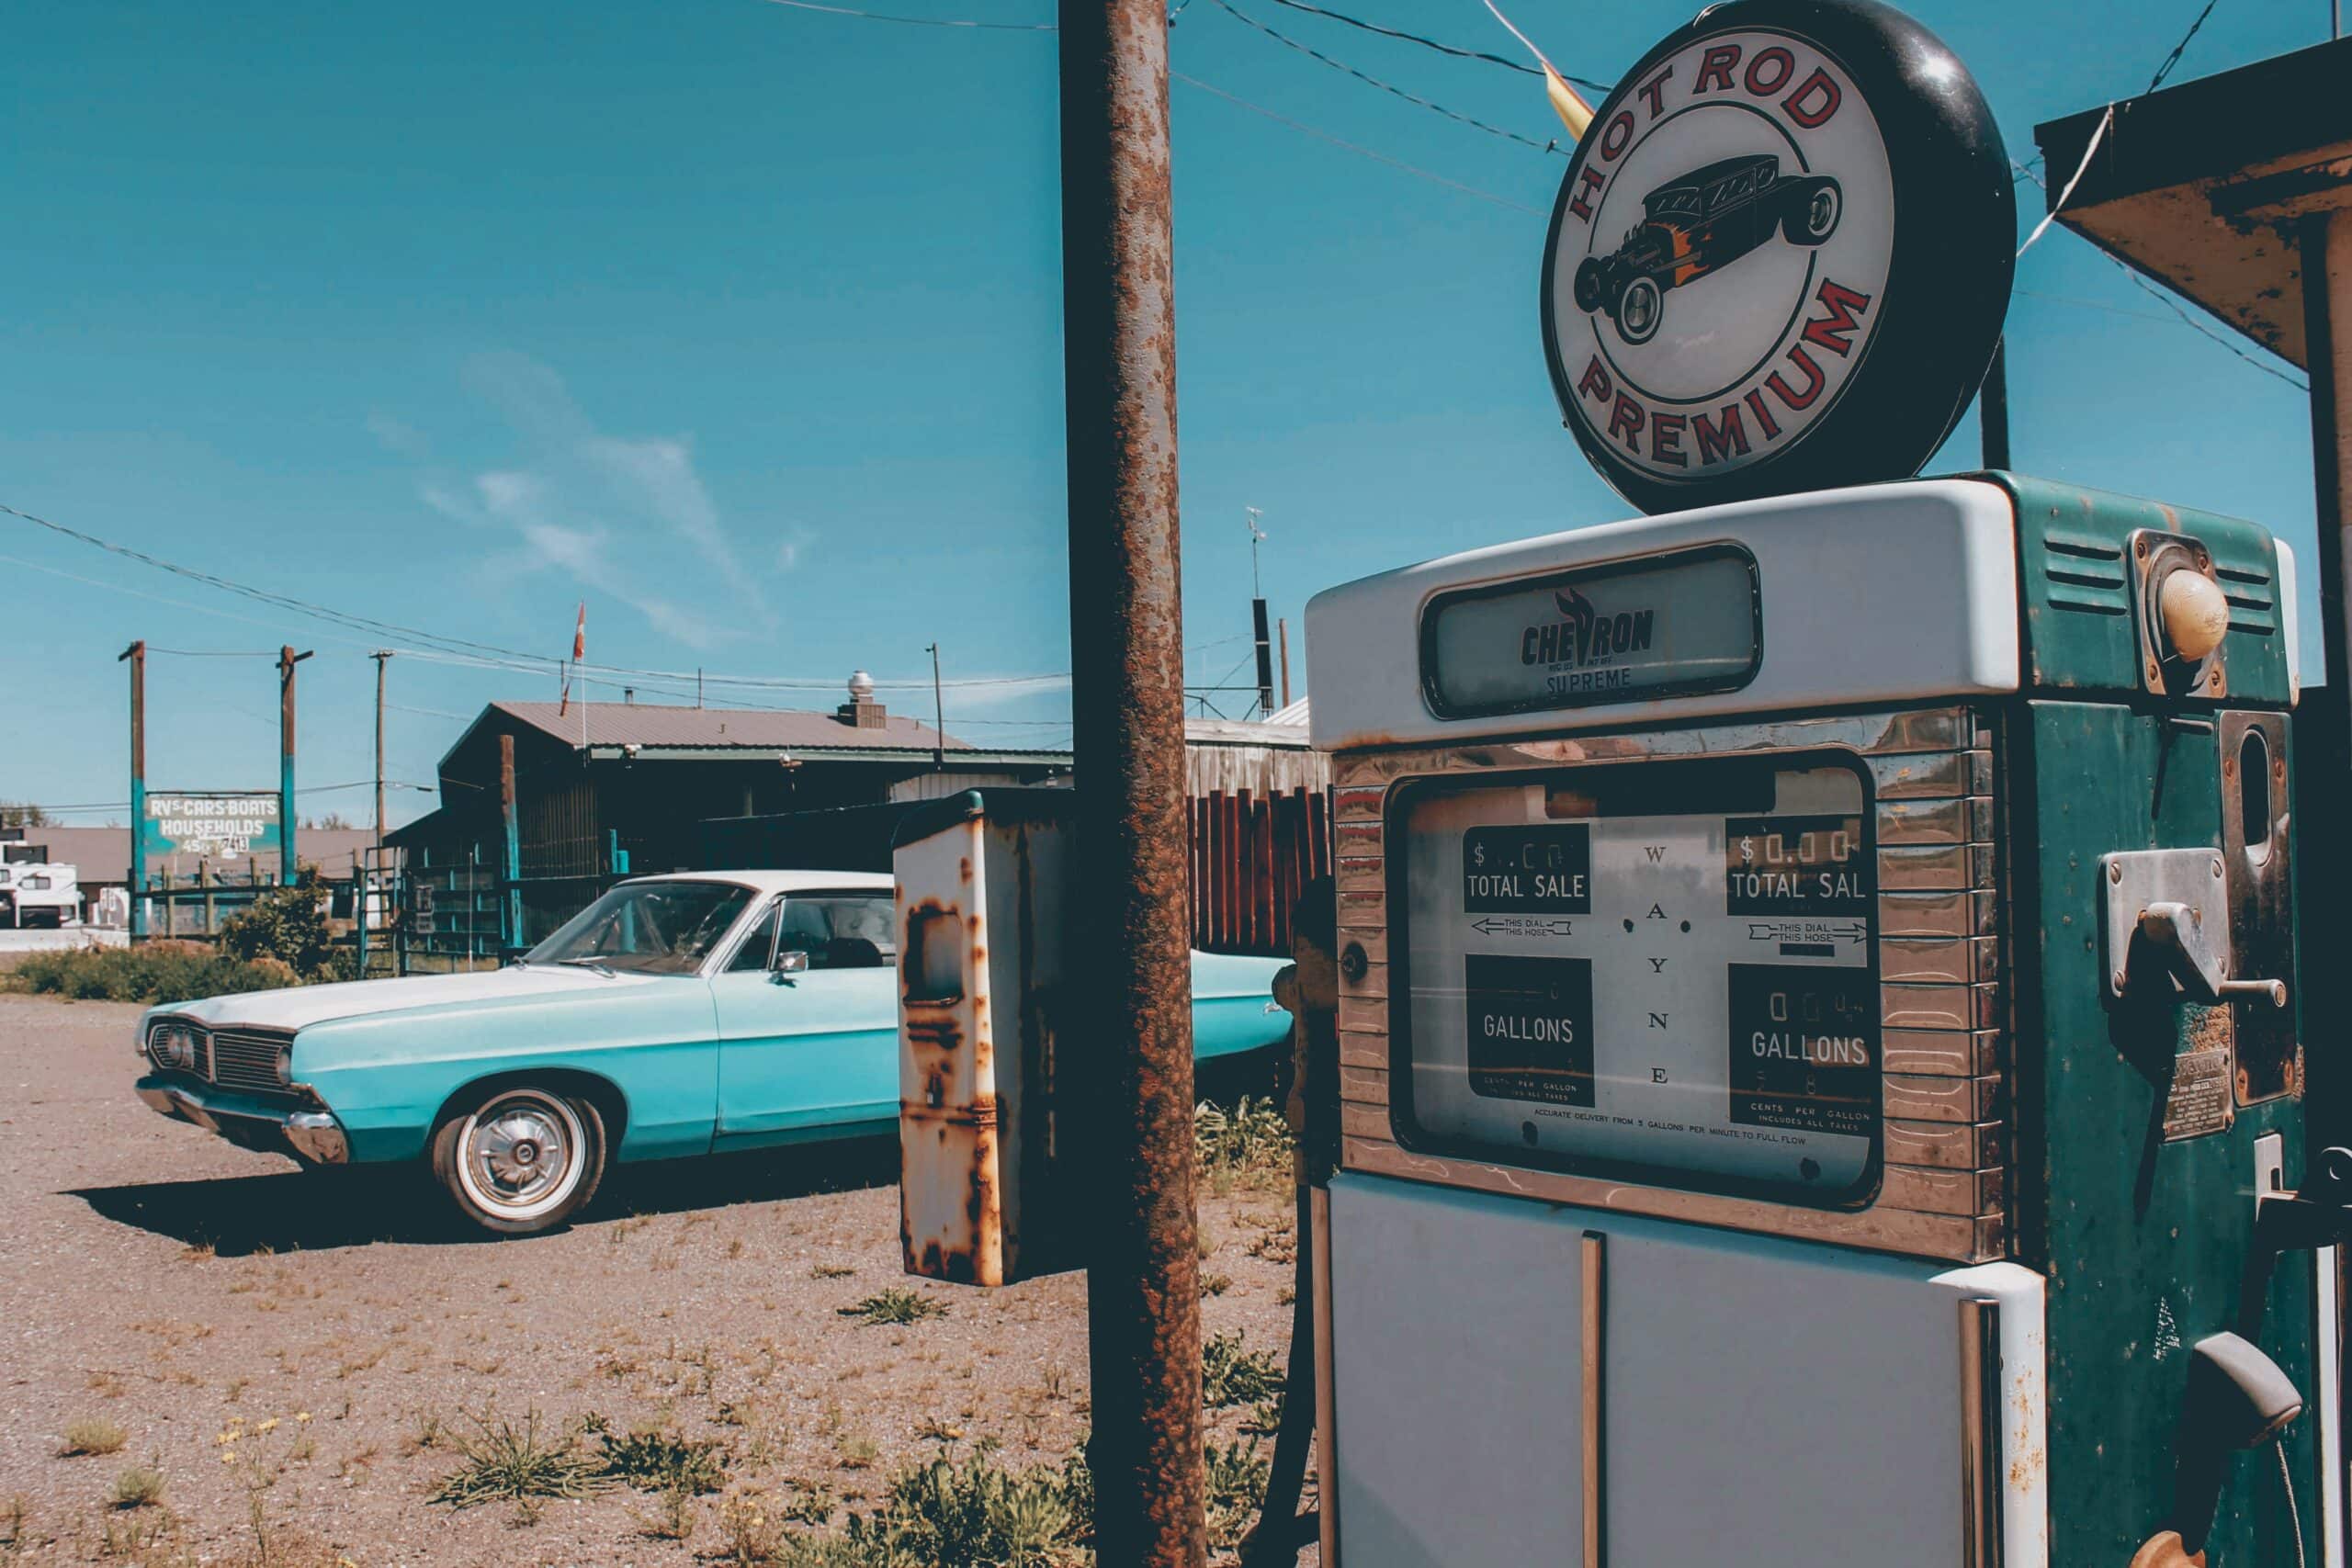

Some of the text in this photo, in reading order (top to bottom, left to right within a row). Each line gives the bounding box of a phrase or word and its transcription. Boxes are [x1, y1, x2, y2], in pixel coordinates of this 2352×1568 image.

[1568, 44, 1842, 225] HOT ROD
[1577, 276, 1871, 469] PREMIUM
[1521, 589, 1654, 667] CHEVRON
[1547, 668, 1631, 694] SUPREME
[161, 819, 265, 837] HOUSEHOLDS
[1468, 874, 1585, 897] TOTAL SALE
[1732, 873, 1805, 898] TOTAL
[1505, 919, 1545, 928] THIS DIAL
[1779, 923, 1831, 932] THIS DIAL
[1779, 933, 1834, 942] THIS HOSE
[1484, 1014, 1573, 1043] GALLONS
[1751, 1031, 1866, 1066] GALLONS
[1543, 1082, 1577, 1092] GALLON
[1750, 1102, 1871, 1122] CENTS PER GALLON
[1758, 1115, 1860, 1132] INCLUDES ALL TAXES
[1534, 1109, 1572, 1119] ACCURATE
[1575, 1112, 1610, 1122] DELIVERY
[1612, 1116, 1634, 1126] FROM
[1647, 1121, 1685, 1132] GALLONS
[1689, 1124, 1706, 1134] PER
[1709, 1127, 1741, 1139] MINUTE
[1743, 1131, 1754, 1140] TO
[1757, 1133, 1779, 1143] FULL
[1781, 1135, 1806, 1145] FLOW
